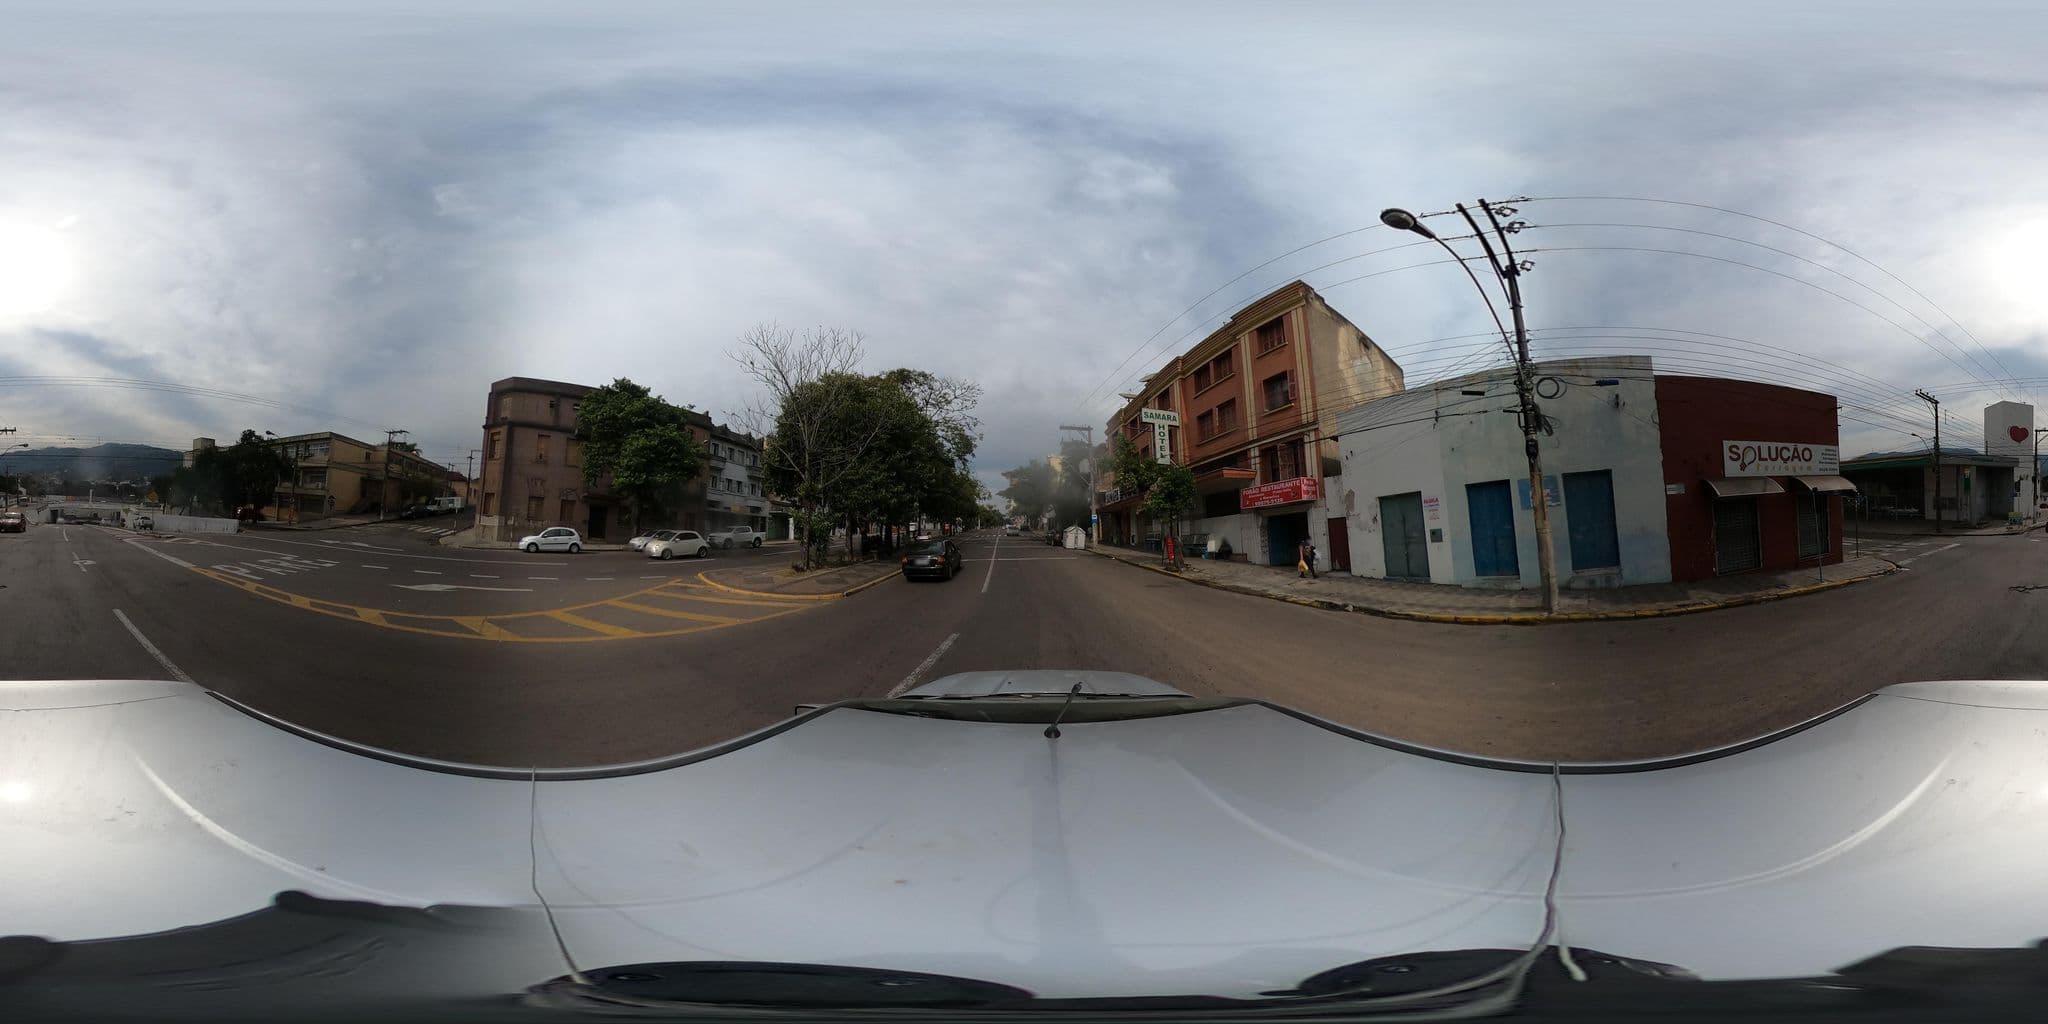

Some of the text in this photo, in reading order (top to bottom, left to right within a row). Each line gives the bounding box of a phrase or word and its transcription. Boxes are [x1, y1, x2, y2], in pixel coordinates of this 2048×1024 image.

[1144, 411, 1177, 422] SAMARA
[1158, 424, 1168, 459] HOTEL
[1728, 444, 1813, 467] SOLUÇÃO
[1260, 480, 1300, 492] RESTAURANTE
